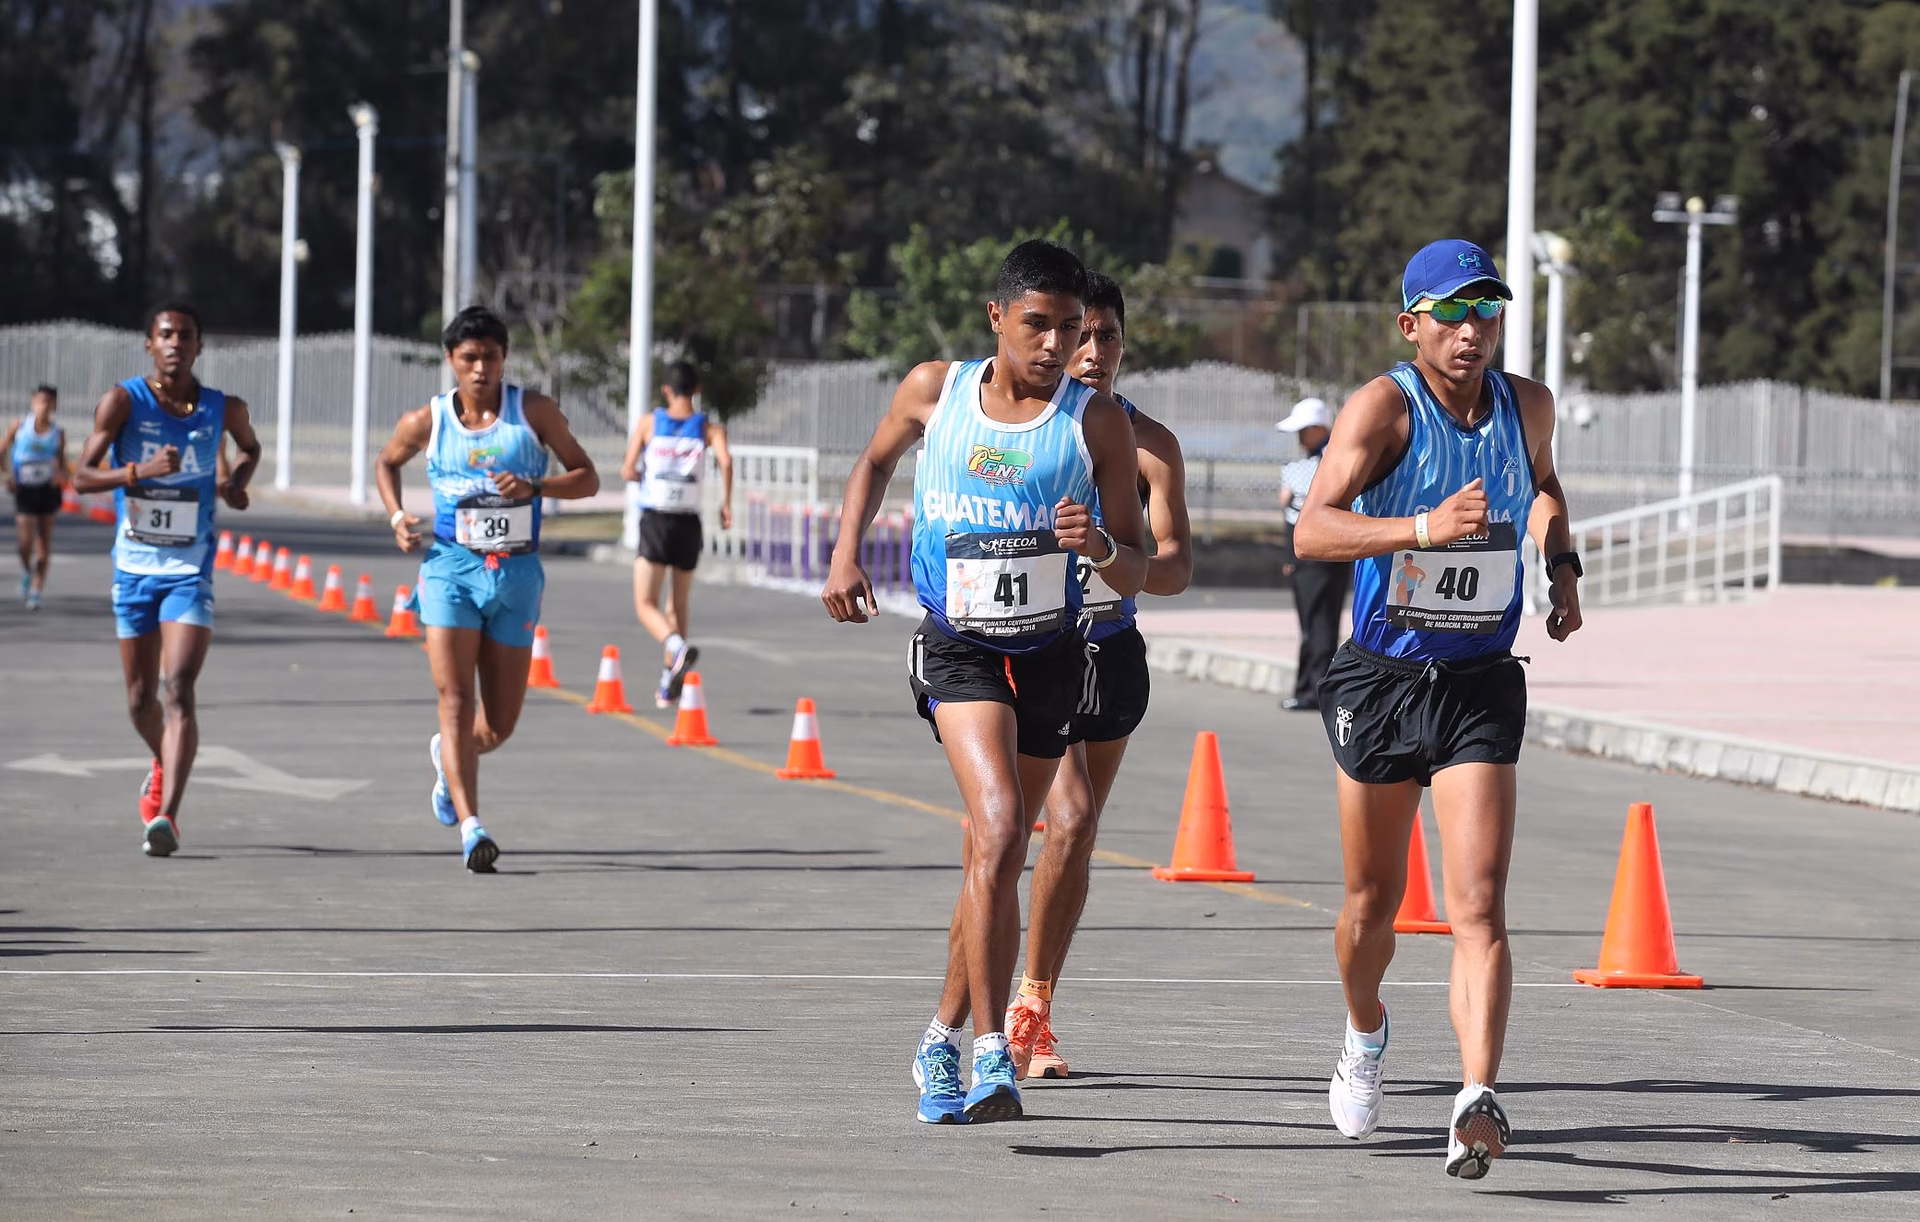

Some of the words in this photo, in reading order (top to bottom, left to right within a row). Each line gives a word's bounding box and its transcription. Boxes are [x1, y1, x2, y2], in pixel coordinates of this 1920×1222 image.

[982, 462, 1026, 480] FNA
[151, 509, 171, 529] 31
[485, 516, 509, 537] 39
[998, 537, 1038, 548] FECOA
[994, 572, 1028, 607] 41
[1435, 566, 1480, 602] 40
[1007, 613, 1058, 626] CENTROAMERICANO
[1406, 610, 1448, 621] CAMPEONATO
[1021, 624, 1036, 633] 2018
[1434, 621, 1461, 629] MARCHA
[1462, 622, 1479, 630] 2018
